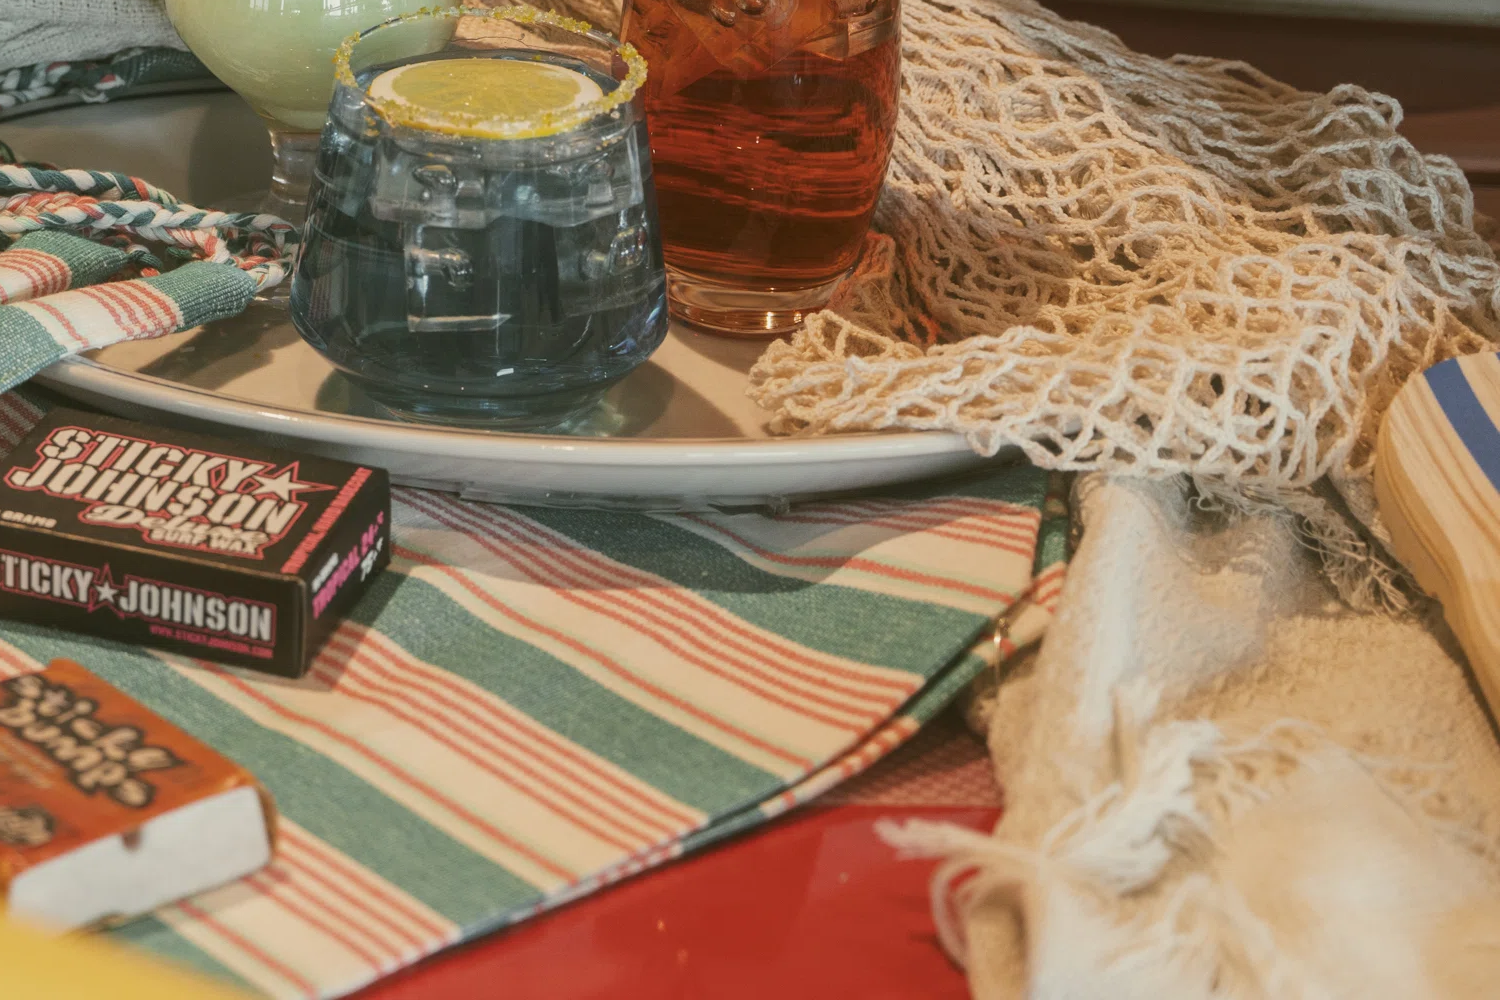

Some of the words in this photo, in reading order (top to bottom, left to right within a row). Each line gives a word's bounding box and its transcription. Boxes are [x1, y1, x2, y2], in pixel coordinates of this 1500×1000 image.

[43, 427, 268, 493] STICKY
[9, 458, 301, 537] JOHNSON
[119, 579, 273, 642] JOHNSON
